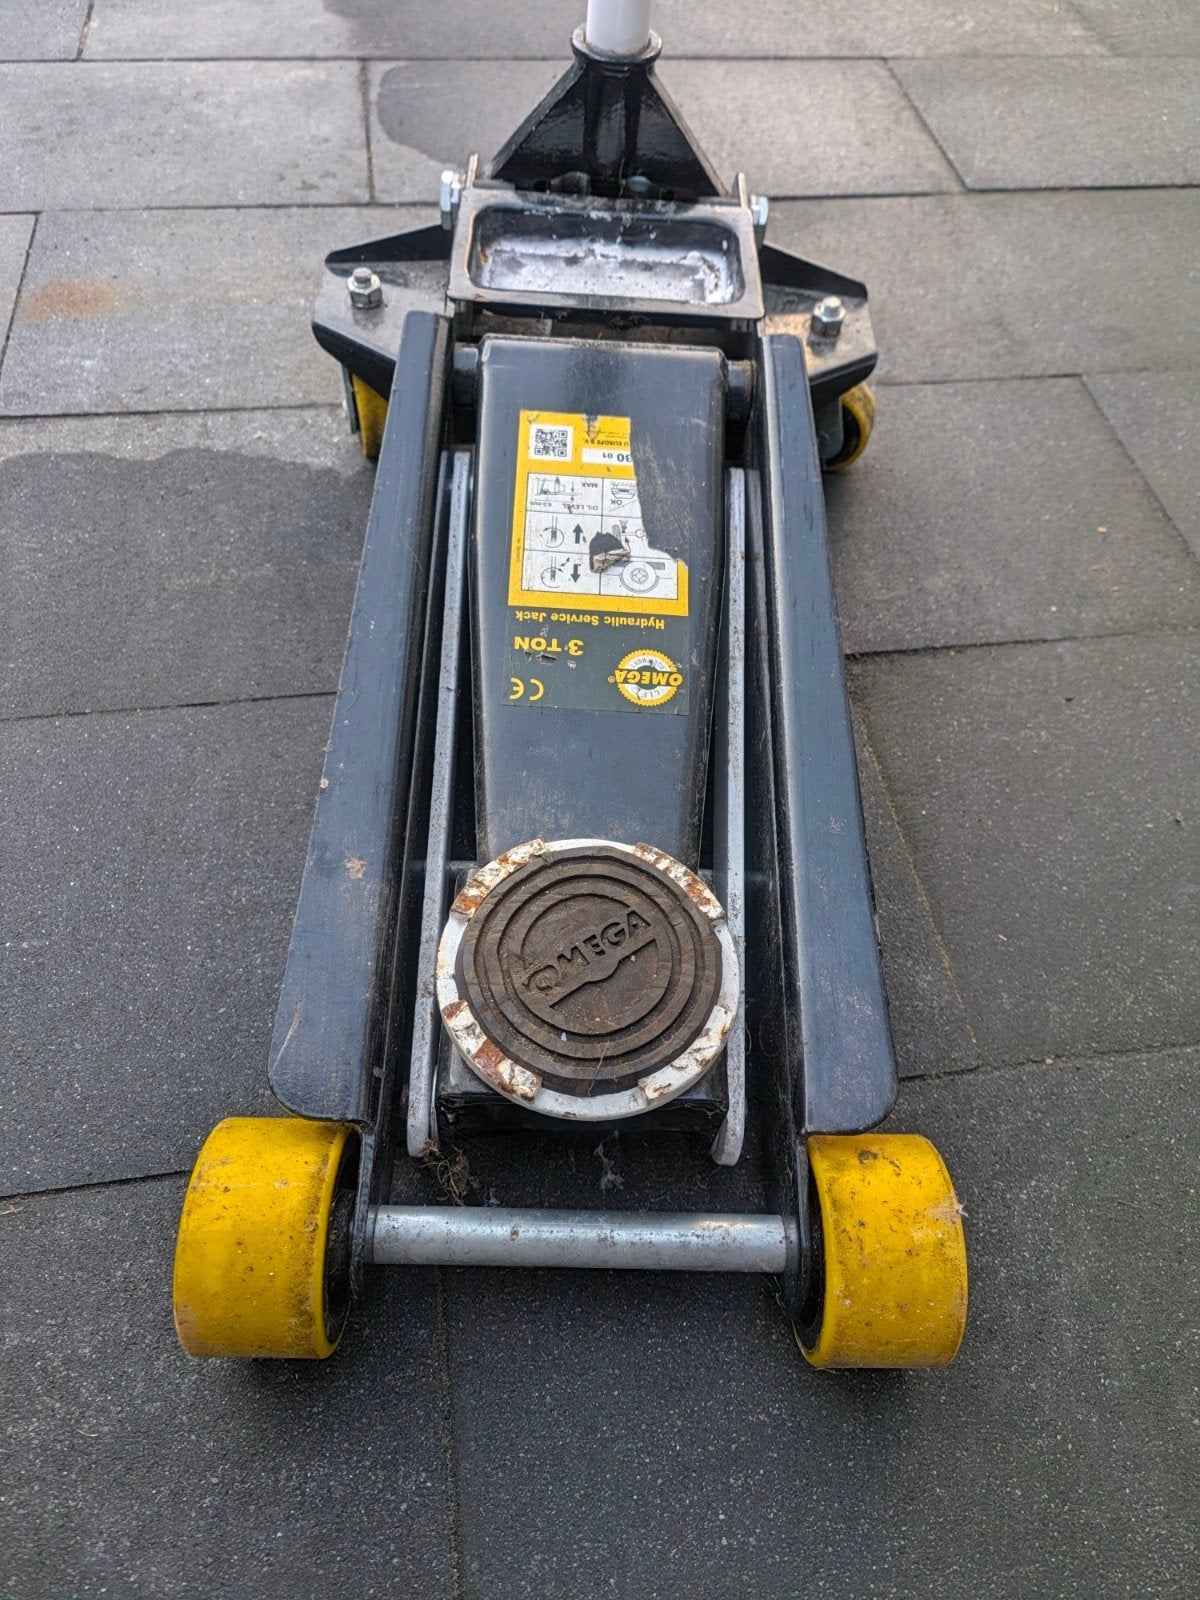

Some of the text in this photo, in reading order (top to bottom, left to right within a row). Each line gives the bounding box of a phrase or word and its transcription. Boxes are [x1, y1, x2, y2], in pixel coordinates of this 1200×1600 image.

[596, 439, 622, 447] EUROPE
[515, 610, 665, 630] Hydraulic Service Jack
[514, 636, 584, 656] 3 TON
[614, 669, 683, 687] OMEGA
